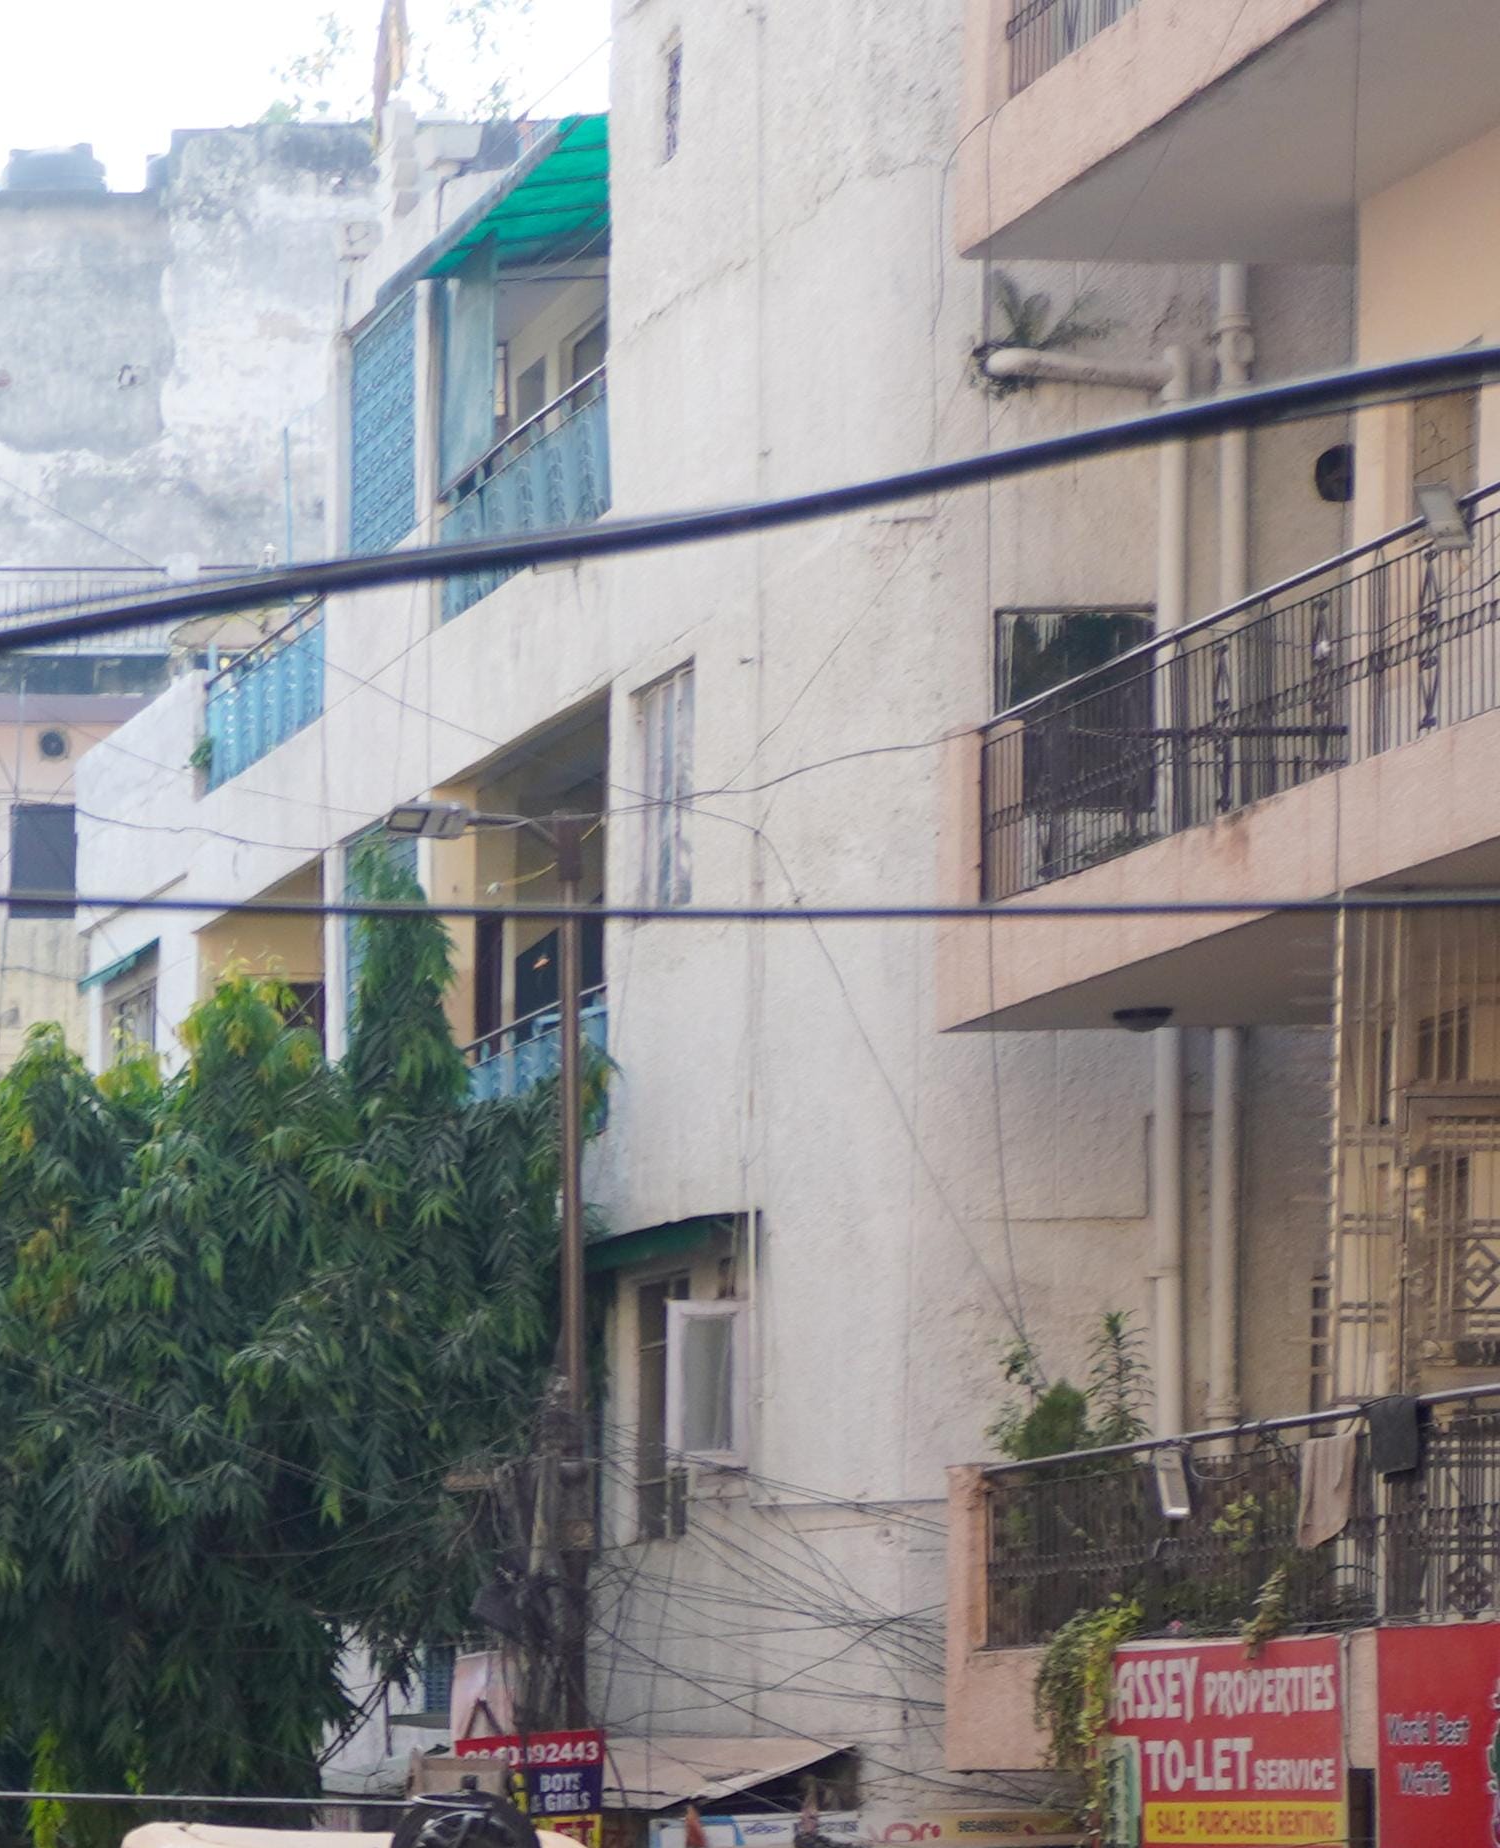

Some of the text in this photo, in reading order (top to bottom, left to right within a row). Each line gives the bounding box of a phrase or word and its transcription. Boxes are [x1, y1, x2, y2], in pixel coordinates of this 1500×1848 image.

[1110, 1656, 1336, 1726] ASSEY PROPERTIES
[1386, 1712, 1470, 1745] World Best
[1145, 1737, 1337, 1792] TO-LET SERVICE
[544, 1791, 591, 1812] GIRLS
